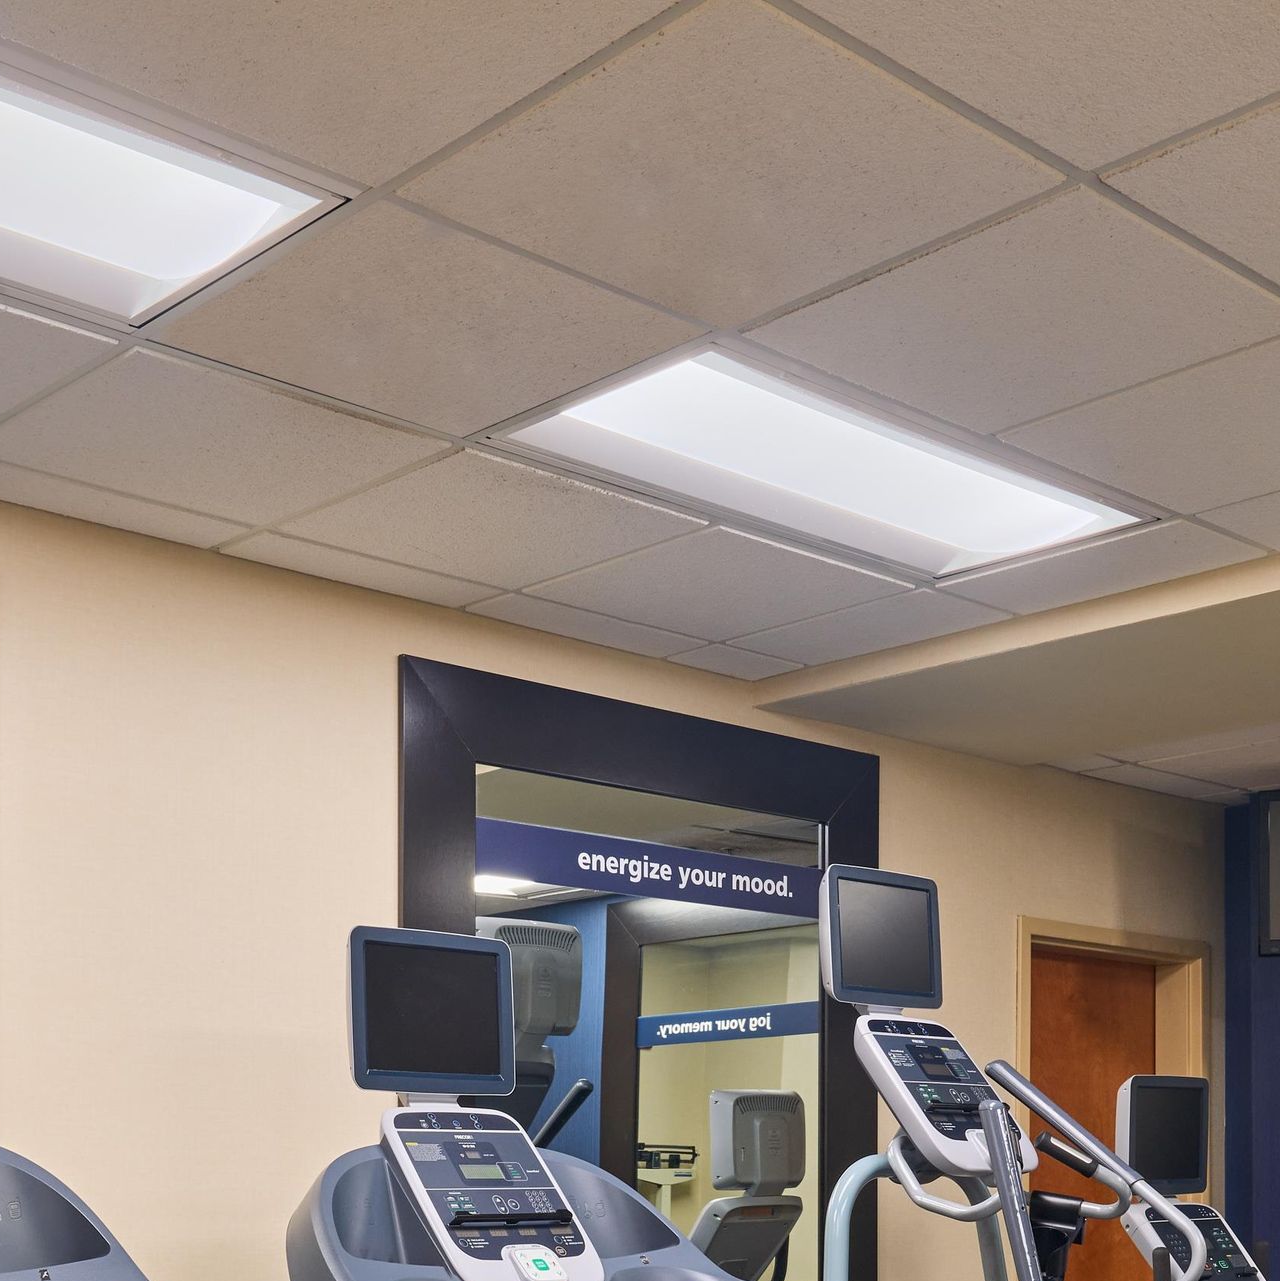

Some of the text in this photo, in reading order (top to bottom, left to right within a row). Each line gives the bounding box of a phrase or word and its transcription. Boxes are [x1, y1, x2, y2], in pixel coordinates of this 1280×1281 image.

[578, 853, 792, 897] energize your mood.
